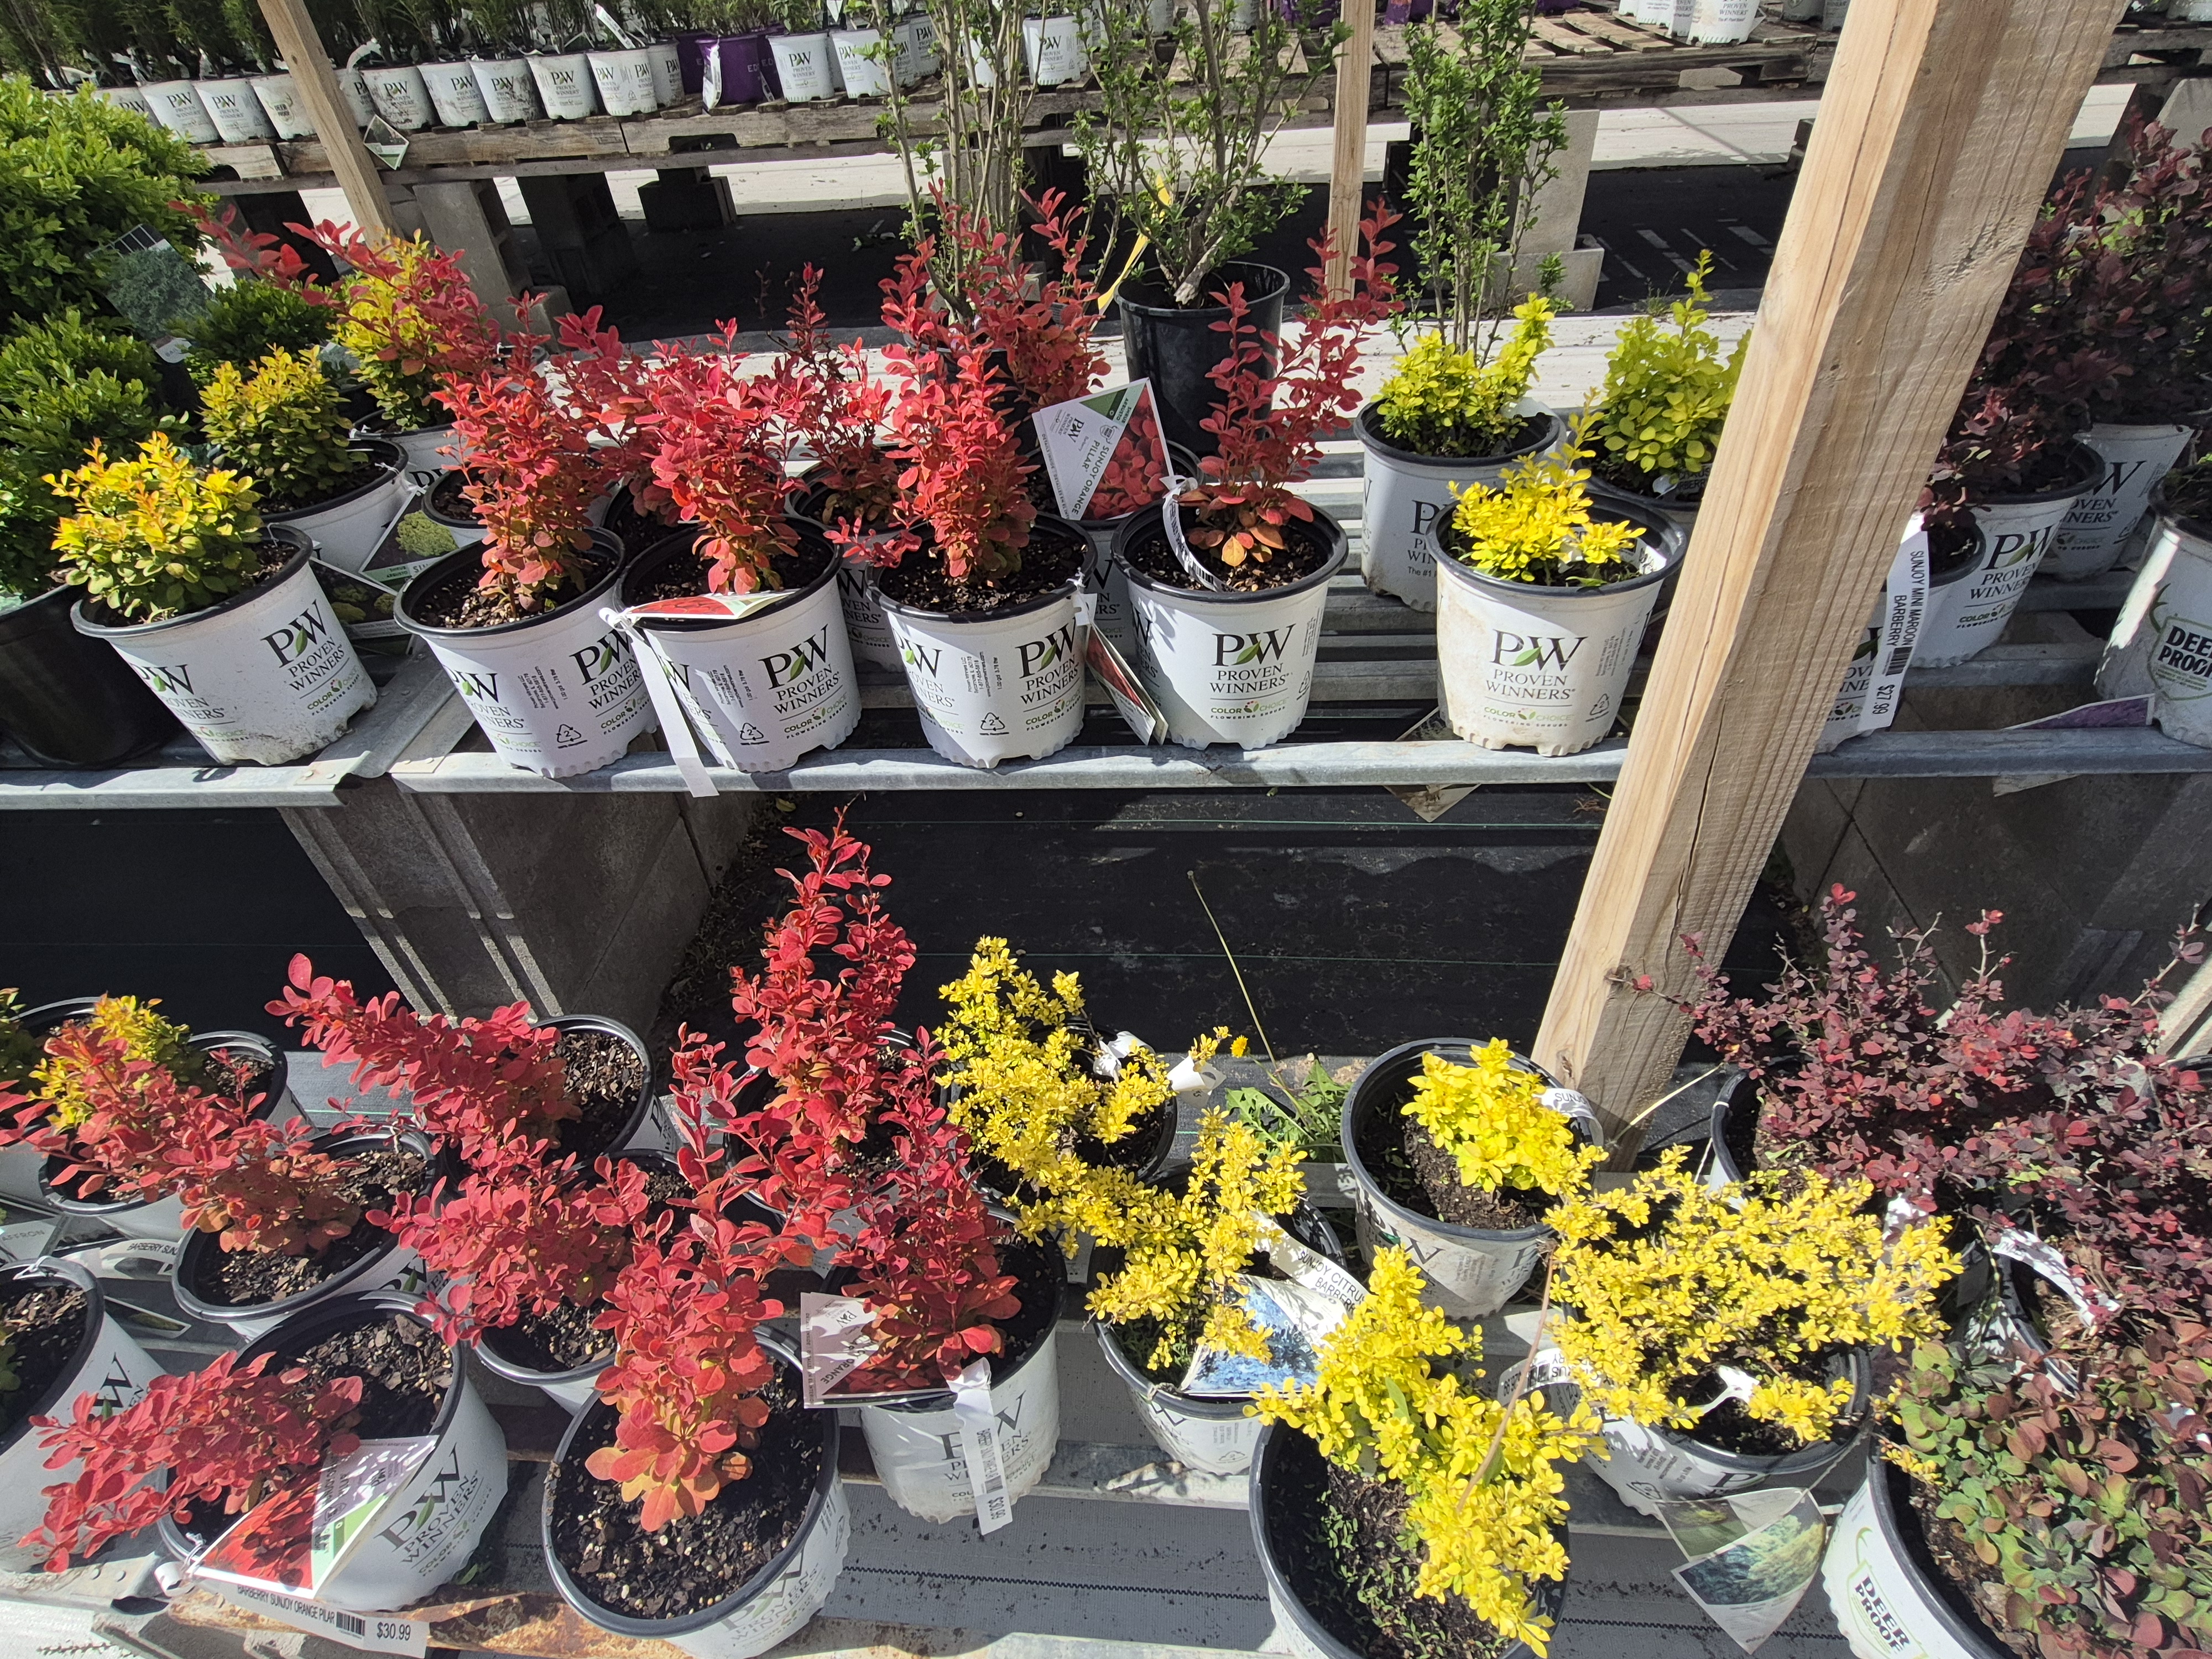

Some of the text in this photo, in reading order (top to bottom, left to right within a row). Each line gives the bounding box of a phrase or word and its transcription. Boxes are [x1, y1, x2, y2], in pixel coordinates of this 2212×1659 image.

[789, 51, 812, 67] PW
[451, 75, 473, 91] PW
[492, 76, 514, 91] PW
[550, 70, 574, 85] PW
[596, 66, 614, 80] PW
[166, 91, 192, 108] PW
[383, 80, 408, 97] PW
[212, 95, 237, 109] PW
[1067, 418, 1085, 443] PW
[1082, 440, 1100, 469] PILLAR
[1071, 445, 1110, 515] SUNJOY ORANGE
[2070, 498, 2117, 510] OVEN
[1981, 524, 2055, 571] PW
[1408, 566, 1421, 576] The
[1901, 550, 1925, 646] SUNJOY MINI MAROON
[1970, 576, 2031, 599] WINNER
[841, 599, 872, 611] OVEN
[1886, 594, 1907, 647] BARBERRY
[260, 599, 327, 668] PW
[1212, 623, 1297, 667] PW
[2166, 624, 2212, 659] DEE
[288, 637, 336, 678] PROVEN
[569, 628, 631, 686] PW
[758, 623, 828, 690] PW
[1015, 616, 1076, 679] PW
[1489, 628, 1589, 672] PW
[289, 644, 345, 691] WINNERS
[589, 654, 638, 696] PROVEN
[1025, 654, 1076, 692] PROVEN
[1217, 662, 1284, 681] PROVEN
[1494, 669, 1569, 687] PROVEN
[773, 671, 839, 714] WINNERS
[775, 664, 833, 701] PROVEN
[909, 670, 944, 693] OVEN
[1020, 661, 1079, 705] WINNERS
[1209, 673, 1290, 694] WINNERS
[1486, 680, 1575, 700] WINNERS
[307, 691, 333, 710] COLOR
[471, 702, 512, 717] OVEN
[916, 688, 955, 708] NERS
[1259, 697, 1288, 712] CHOICE
[1872, 684, 1896, 714] $27.99
[176, 707, 225, 719] NNERS
[601, 711, 627, 729] COLOR
[784, 692, 847, 733] COLOR CHOICE
[1025, 711, 1053, 726] COLOR
[1026, 712, 1065, 732] FLOWERING
[1260, 706, 1286, 717] SHRUBS
[1483, 714, 1531, 727] FLOWERING
[1484, 706, 1516, 718] COLOR
[786, 719, 827, 739] FLOWERING
[1, 1229, 45, 1241] AFFRON
[127, 1243, 162, 1252] BARBERRY
[1297, 1250, 1332, 1276] SUNJOY
[1314, 1276, 1356, 1315] BARBERR
[836, 1310, 857, 1328] PW
[820, 1358, 855, 1384] ORANGE
[373, 1442, 460, 1553] PW
[400, 1470, 479, 1563] WINNERS
[403, 1475, 469, 1553] PROVEN
[418, 1542, 453, 1574] COLOR
[237, 1585, 336, 1625] BARBERRY SUNJOY ORANGE PILAR
[1862, 1575, 1911, 1648] DEER
[1854, 1583, 1904, 1654] PROOF
[377, 1621, 411, 1641] $30.99
